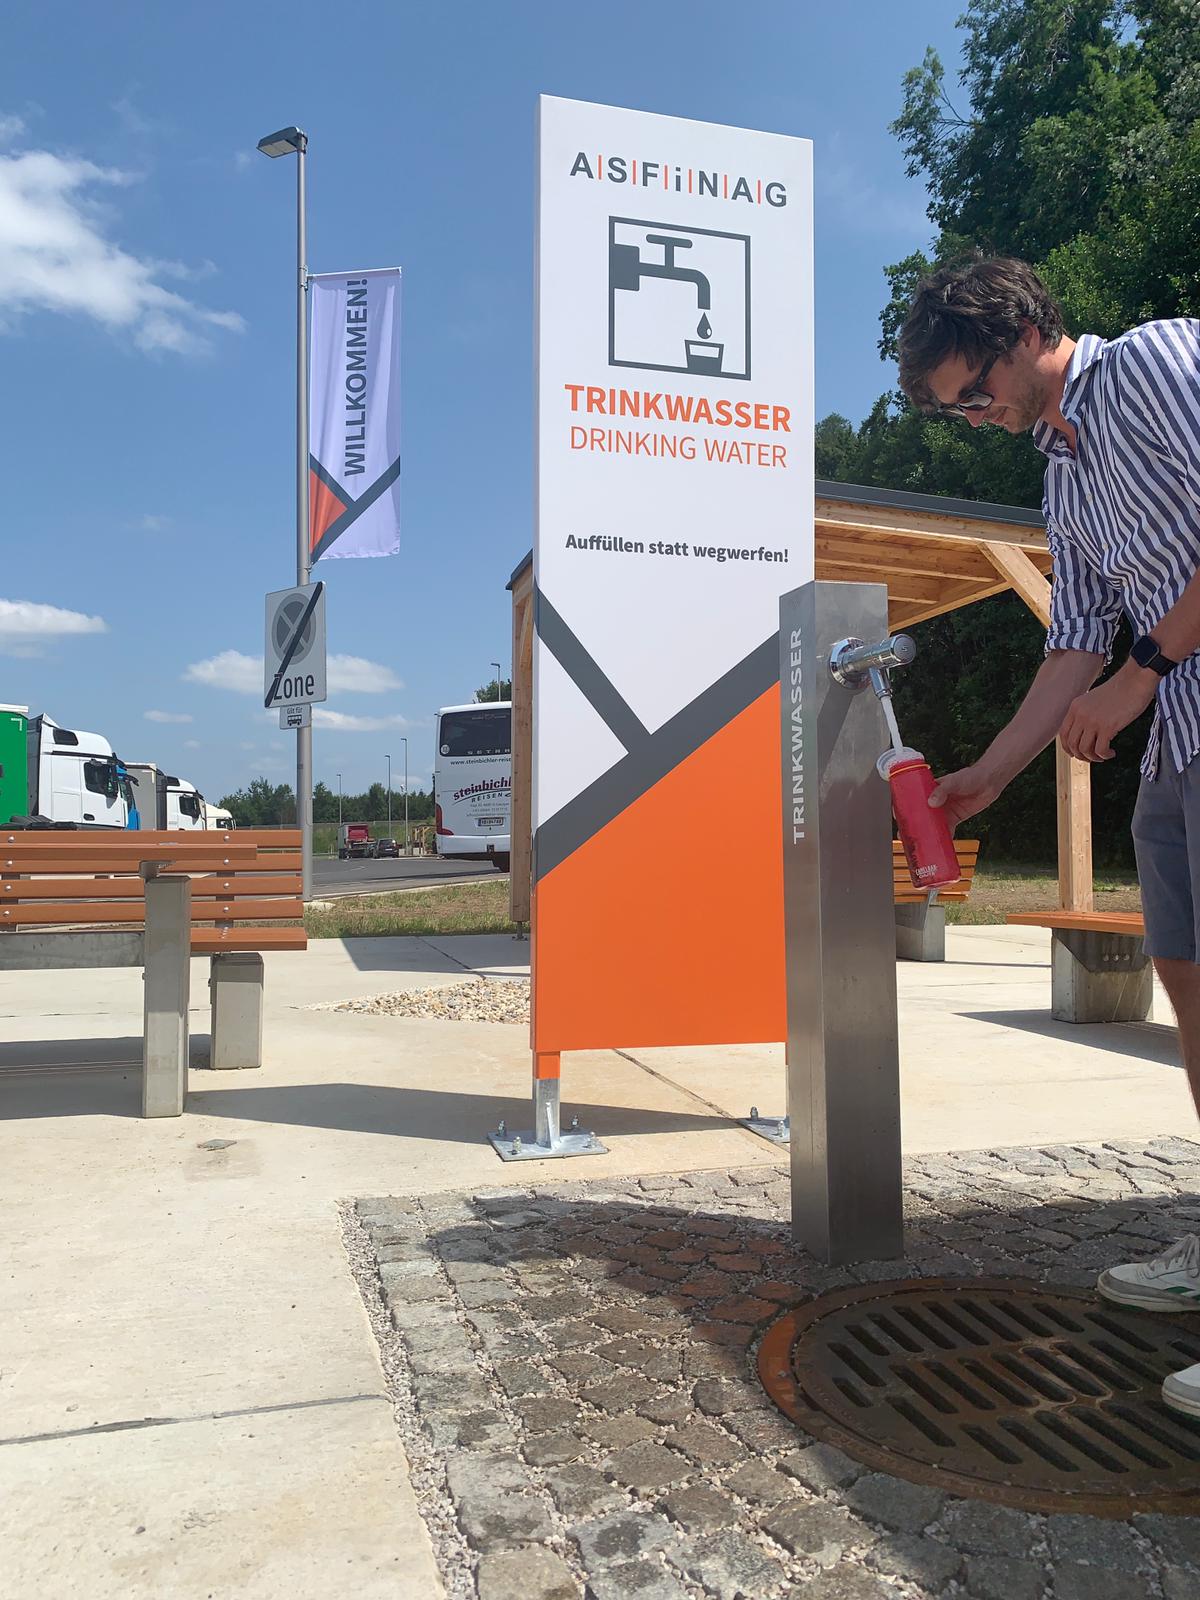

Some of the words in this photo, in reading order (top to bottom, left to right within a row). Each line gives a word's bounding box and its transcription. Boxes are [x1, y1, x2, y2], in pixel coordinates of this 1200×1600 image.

[344, 279, 368, 477] WILLKOMMEN!
[564, 384, 791, 432] TRINKWASSER
[570, 426, 696, 460] DRINKING
[704, 438, 787, 468] WATER
[565, 534, 644, 553] Auffüllen
[648, 541, 689, 557] statt
[693, 547, 789, 562] wegwerfen!
[274, 673, 314, 701] Zone
[791, 628, 805, 844] TRINKWASSER
[471, 792, 503, 803] REISEN
